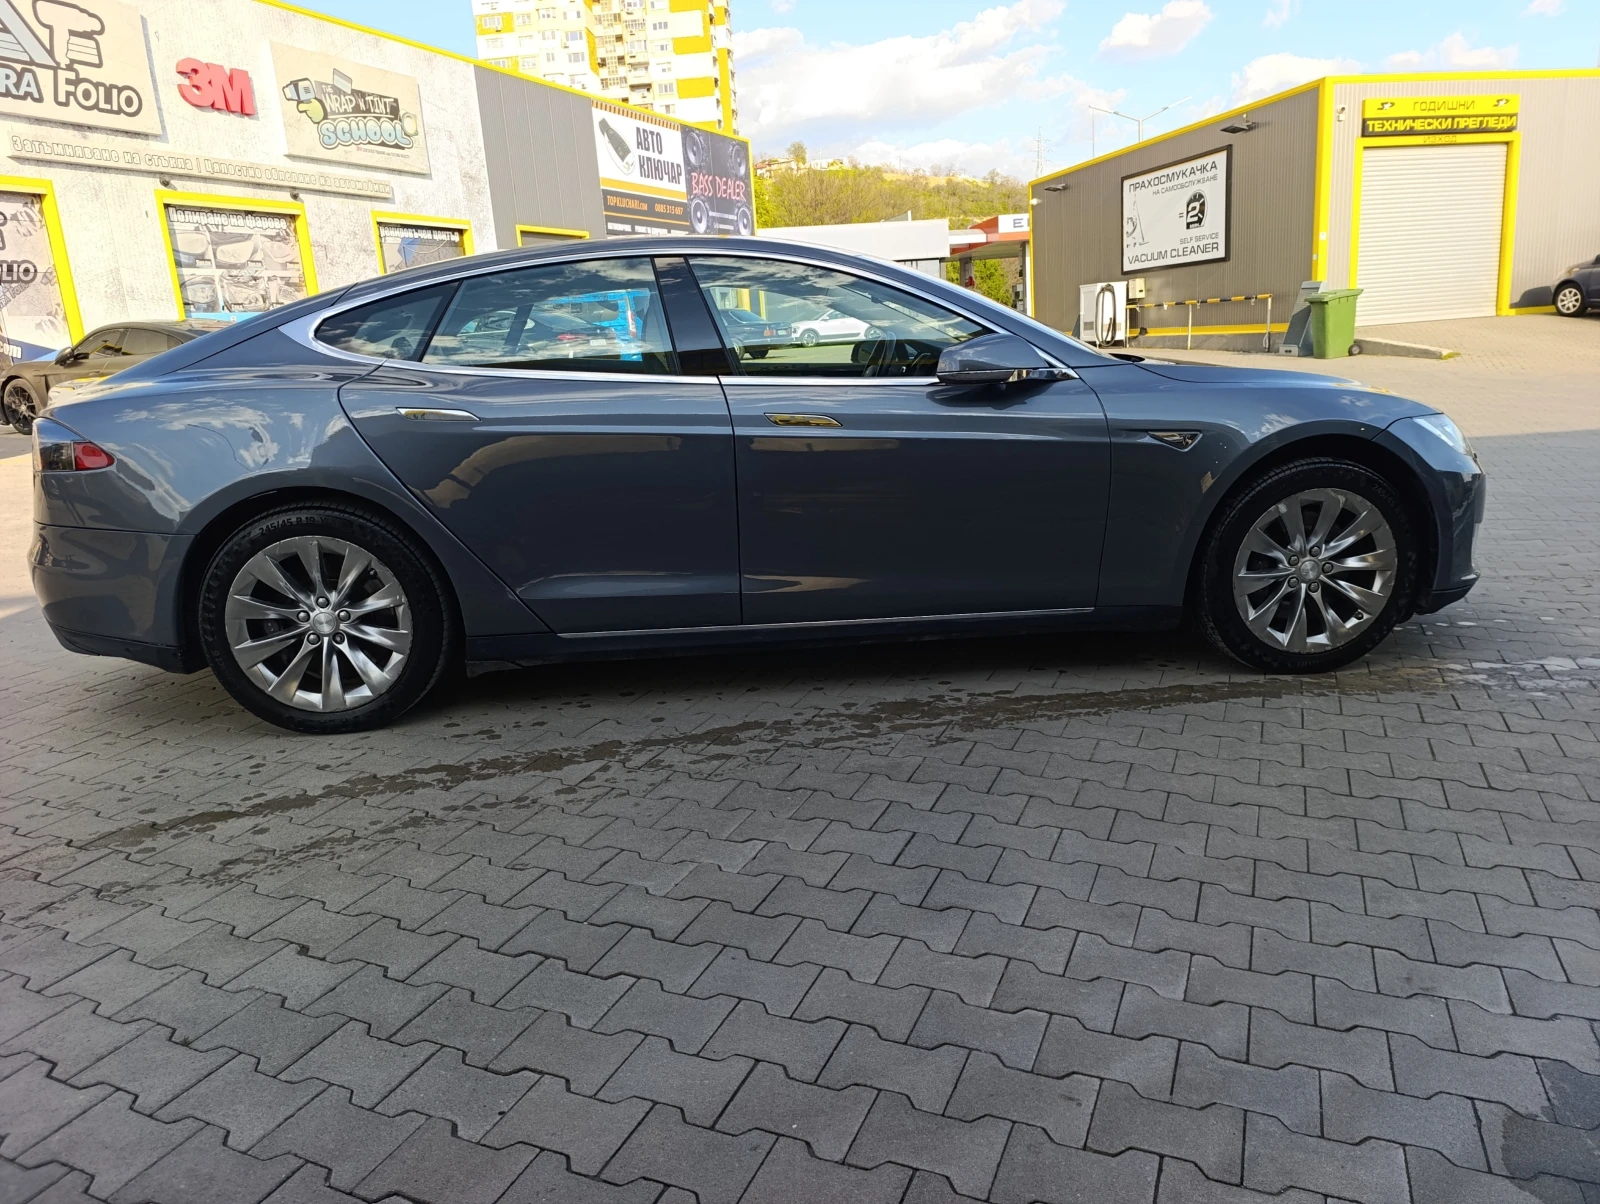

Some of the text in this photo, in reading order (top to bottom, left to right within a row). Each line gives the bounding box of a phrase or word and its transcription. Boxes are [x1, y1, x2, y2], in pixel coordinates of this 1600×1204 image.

[55, 67, 141, 116] FOLIO
[176, 58, 256, 116] 3M
[321, 84, 334, 93] THE
[321, 93, 356, 113] WRAP
[365, 95, 395, 114] TINT
[1413, 100, 1475, 112] ГОДИШНИ
[318, 117, 413, 149] SCHOOL
[1366, 115, 1517, 132] ТЕХНИЧЕСКИ ПРЕГЛЕДИ
[636, 126, 663, 155] АВТО
[1423, 135, 1458, 144] ИЗХОД
[11, 135, 120, 163] Затъмняване
[123, 151, 142, 166] на
[144, 153, 194, 171] стъкла
[203, 158, 263, 179] Цялостно
[265, 167, 318, 185] облепяне
[319, 174, 333, 188] на
[334, 175, 392, 194] автомобили
[638, 154, 683, 185] КЛЮЧАР
[691, 172, 746, 202] BASS DEALER
[1128, 161, 1218, 193] ПРАХОСМУКАЧКА
[1161, 173, 1219, 194] САМООБСЛУЖВАНЕ
[167, 206, 288, 230] Полиране на фарове
[1186, 201, 1200, 223] 2
[379, 225, 433, 240] ренировъчен
[1180, 232, 1220, 245] SELF SERVICE
[1127, 242, 1220, 265] VACUUM CLEANER
[0, 260, 37, 284] LIO
[258, 517, 294, 536] 245/45
